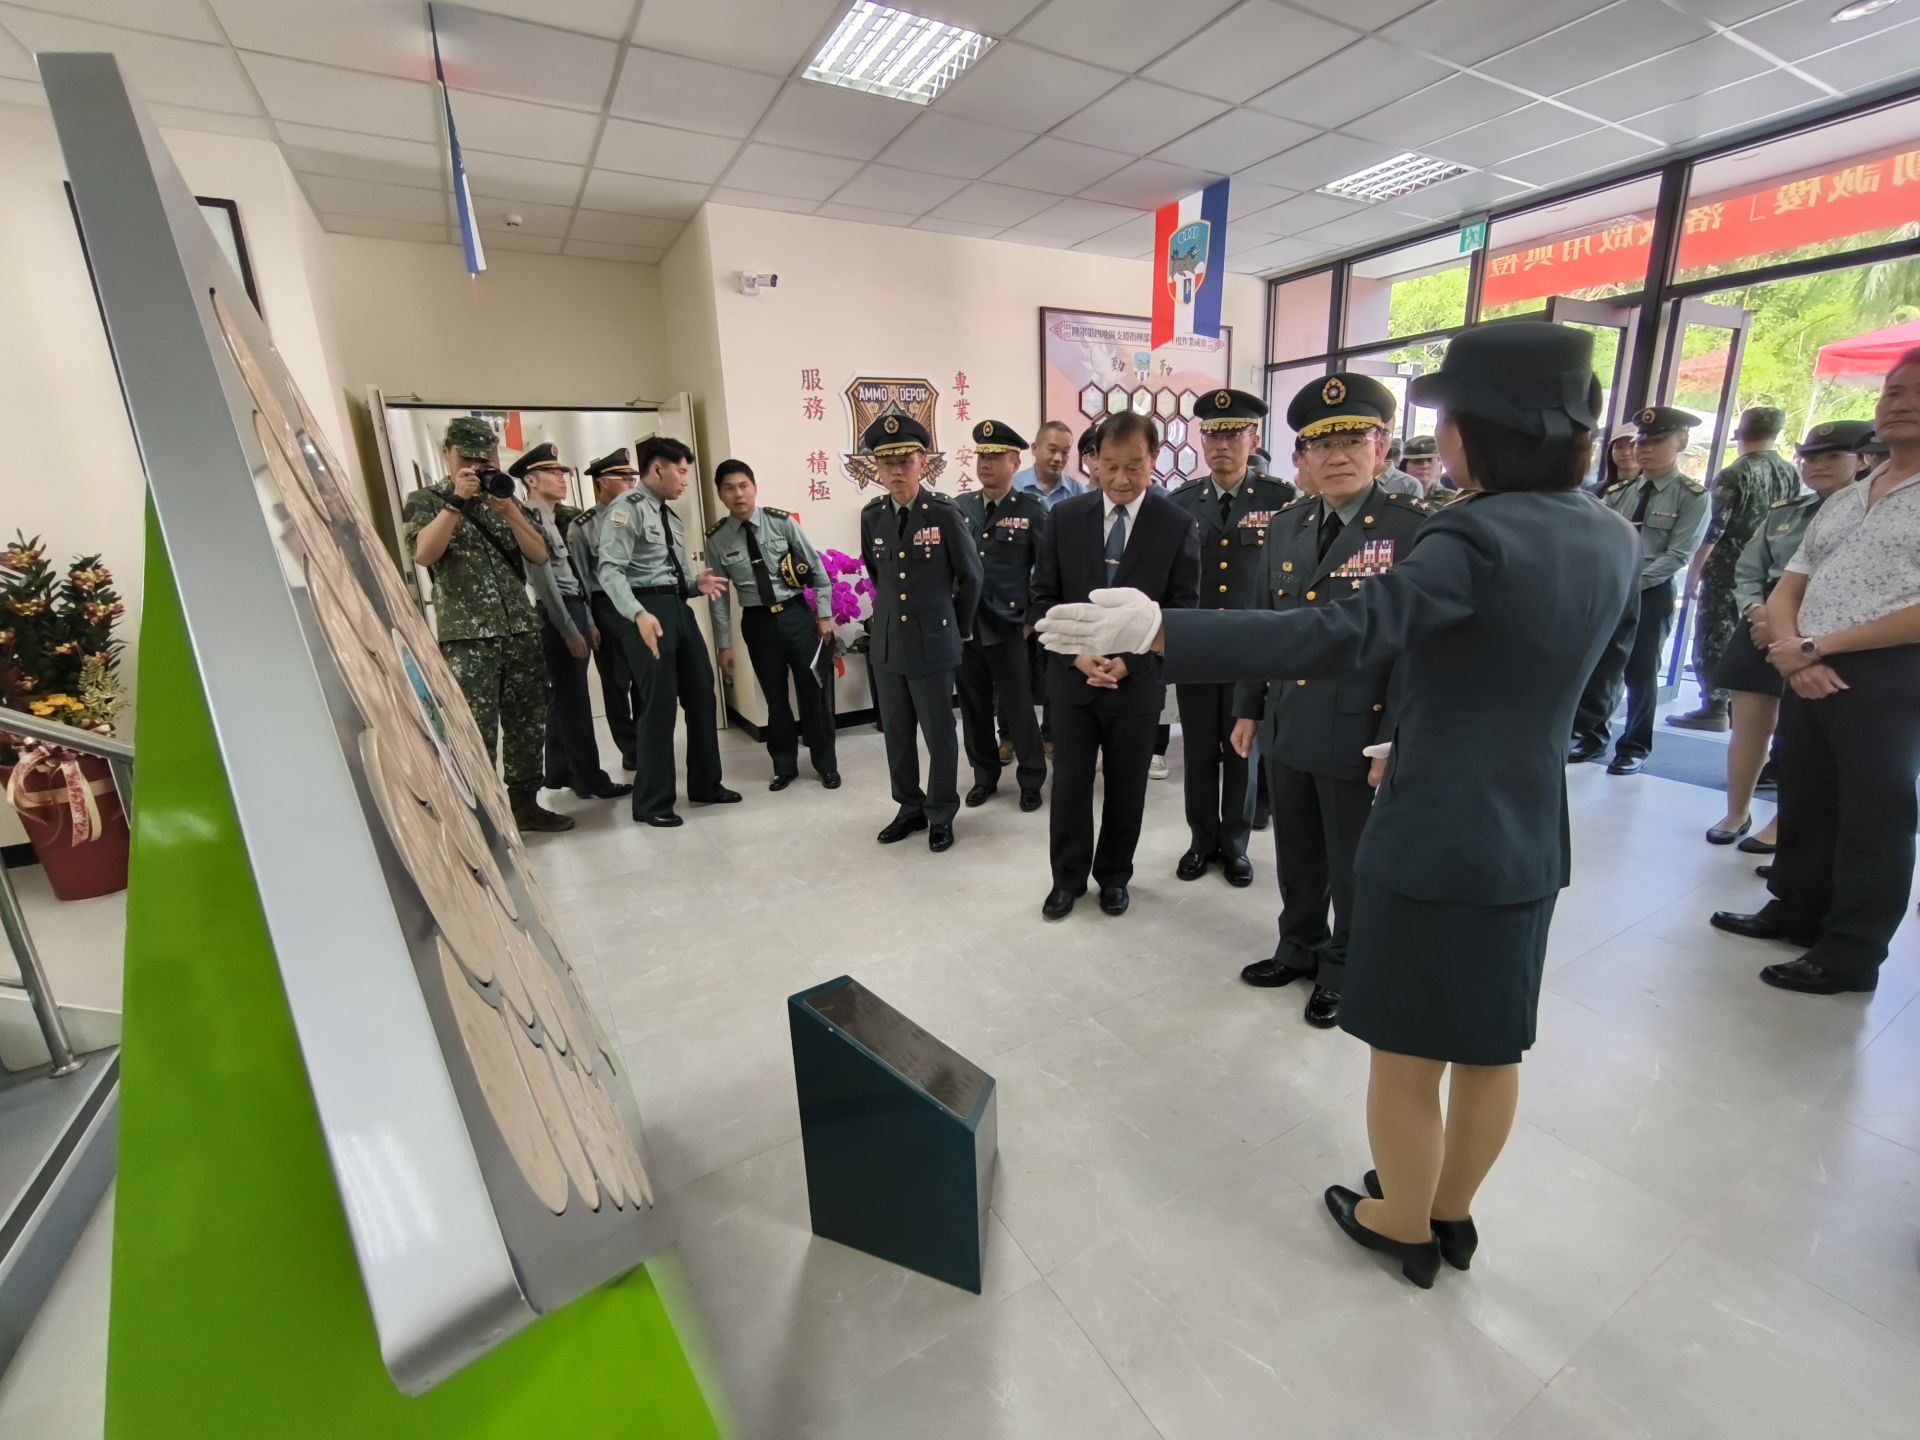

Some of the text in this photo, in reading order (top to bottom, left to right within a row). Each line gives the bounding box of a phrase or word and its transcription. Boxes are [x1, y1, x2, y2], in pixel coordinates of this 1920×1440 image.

[801, 368, 831, 501] 服務 積極
[858, 386, 926, 401] AMMO DEPOT
[952, 371, 974, 492] 專業 安全
